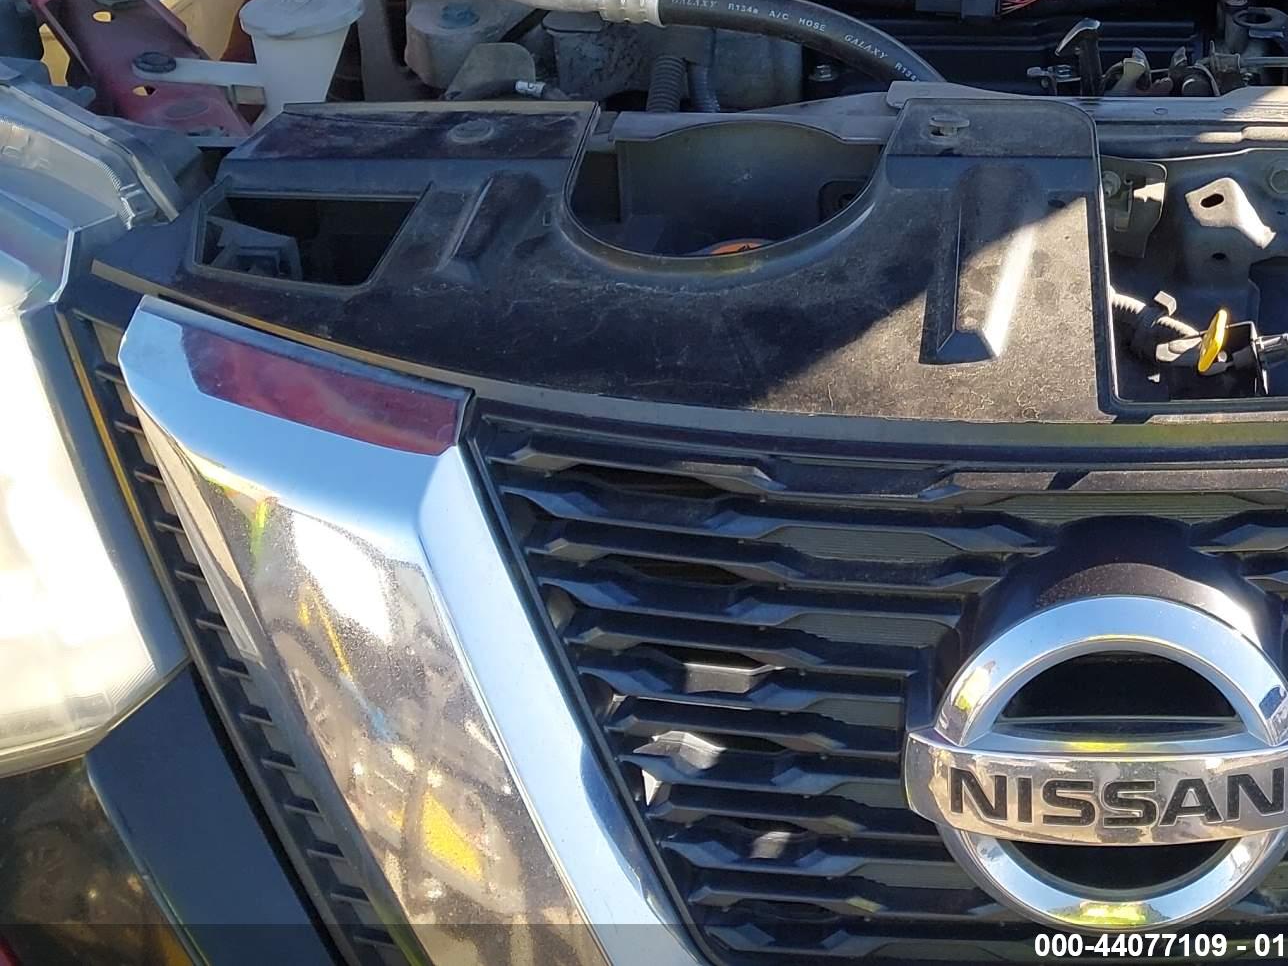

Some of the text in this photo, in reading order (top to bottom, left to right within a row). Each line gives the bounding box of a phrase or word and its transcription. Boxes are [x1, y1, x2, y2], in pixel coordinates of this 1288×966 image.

[768, 9, 790, 21] A/C
[798, 17, 826, 32] HOSE
[844, 34, 888, 59] GALAXY
[949, 767, 1286, 828] NISSAN
